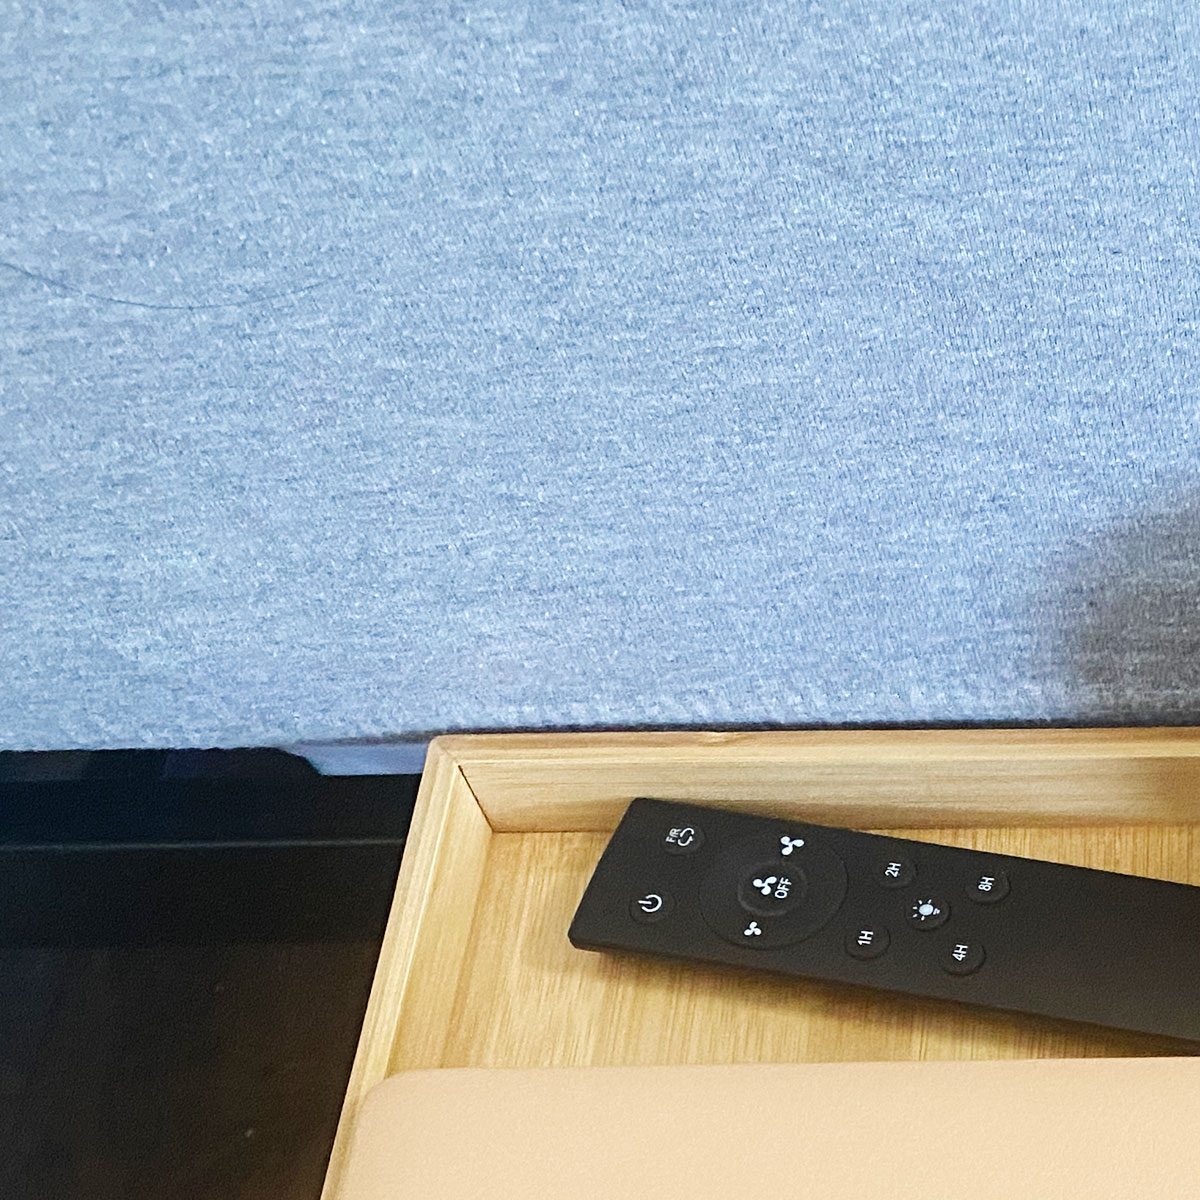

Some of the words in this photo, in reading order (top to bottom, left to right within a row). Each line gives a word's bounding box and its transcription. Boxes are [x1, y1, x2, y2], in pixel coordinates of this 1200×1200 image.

[885, 862, 902, 878] 2H
[774, 876, 792, 899] OFF
[978, 876, 995, 892] 8H
[857, 930, 874, 946] 1H
[952, 944, 969, 961] 4H
